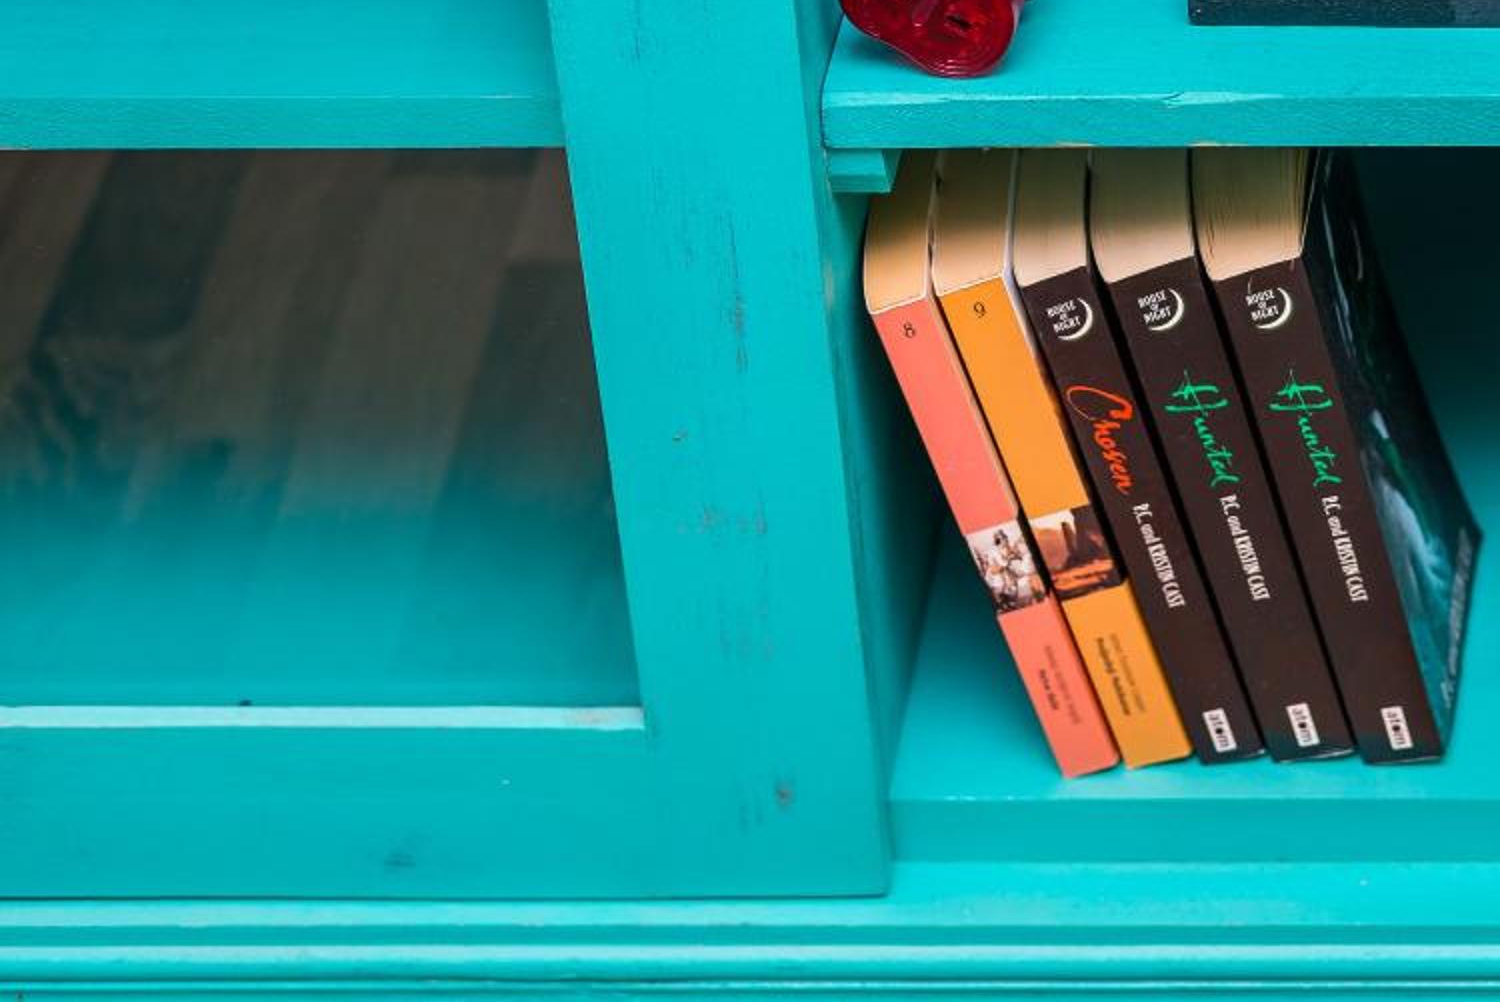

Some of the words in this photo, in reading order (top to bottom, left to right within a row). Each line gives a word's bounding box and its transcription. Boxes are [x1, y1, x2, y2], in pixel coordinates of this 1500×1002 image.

[973, 301, 987, 318] 9
[1046, 299, 1076, 318] HOUSE
[1137, 290, 1168, 309] HOUSE
[1246, 289, 1276, 307] HOUSE
[1052, 315, 1081, 334] NIGHT
[1144, 306, 1172, 324] NIGHT
[1251, 306, 1280, 323] NIGHT
[903, 322, 915, 339] 8
[1066, 384, 1134, 495] Chosen
[1165, 369, 1241, 487] Hunted
[1269, 369, 1343, 487] Hunted
[1139, 524, 1160, 546] and
[1227, 515, 1248, 538] and
[1327, 515, 1347, 538] and
[1147, 542, 1176, 583] KRISTIN
[1234, 536, 1262, 574] KRISTIN
[1334, 536, 1361, 574] KRISTIN
[1161, 580, 1185, 608] CAST
[1247, 574, 1270, 601] CAST
[1346, 574, 1369, 601] CAST
[1206, 713, 1235, 751] atom
[1290, 707, 1318, 746] atom
[1386, 710, 1413, 748] atom
